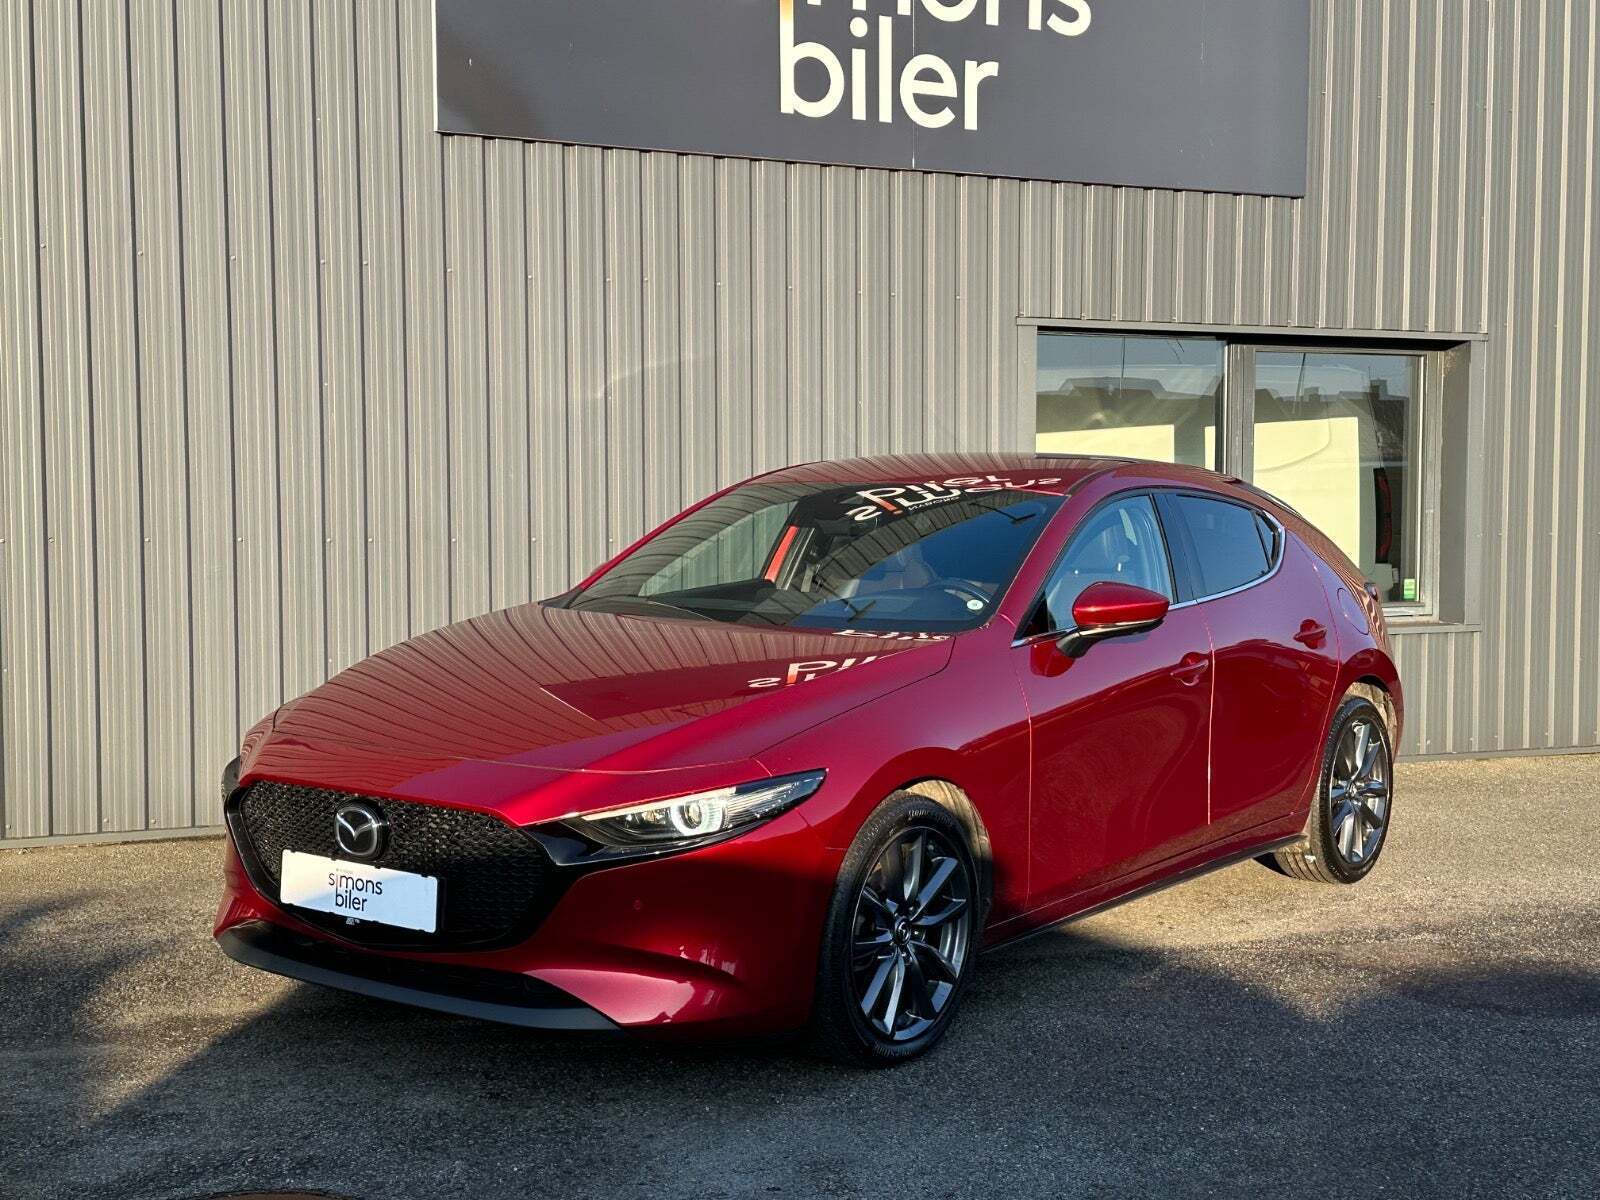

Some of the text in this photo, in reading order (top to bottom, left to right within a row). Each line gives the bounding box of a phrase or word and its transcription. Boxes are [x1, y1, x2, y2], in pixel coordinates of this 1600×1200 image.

[780, 6, 999, 131] biler
[328, 870, 383, 895] simons
[335, 889, 368, 911] biler
